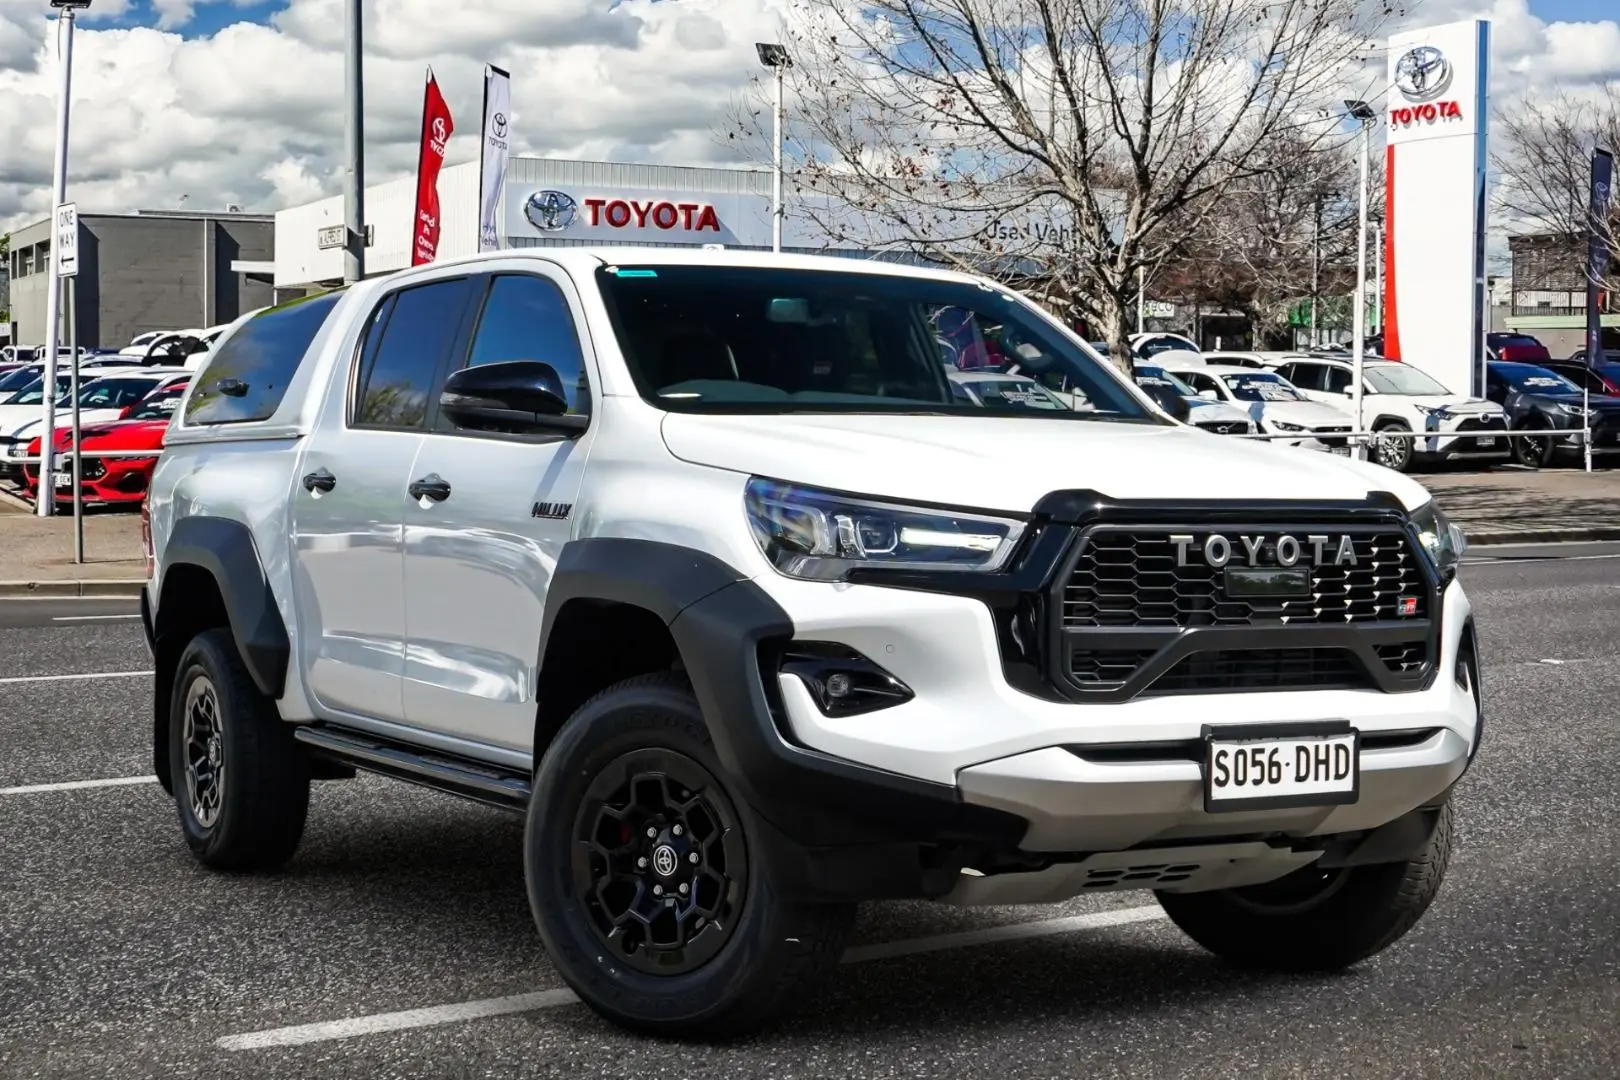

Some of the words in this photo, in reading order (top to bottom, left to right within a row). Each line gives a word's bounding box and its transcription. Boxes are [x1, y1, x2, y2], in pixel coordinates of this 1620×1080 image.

[1390, 101, 1461, 124] TOYOTA
[60, 209, 74, 228] ONE
[584, 198, 721, 232] TOYOTA
[60, 231, 76, 249] WAY
[1169, 534, 1358, 568] TOYOTA
